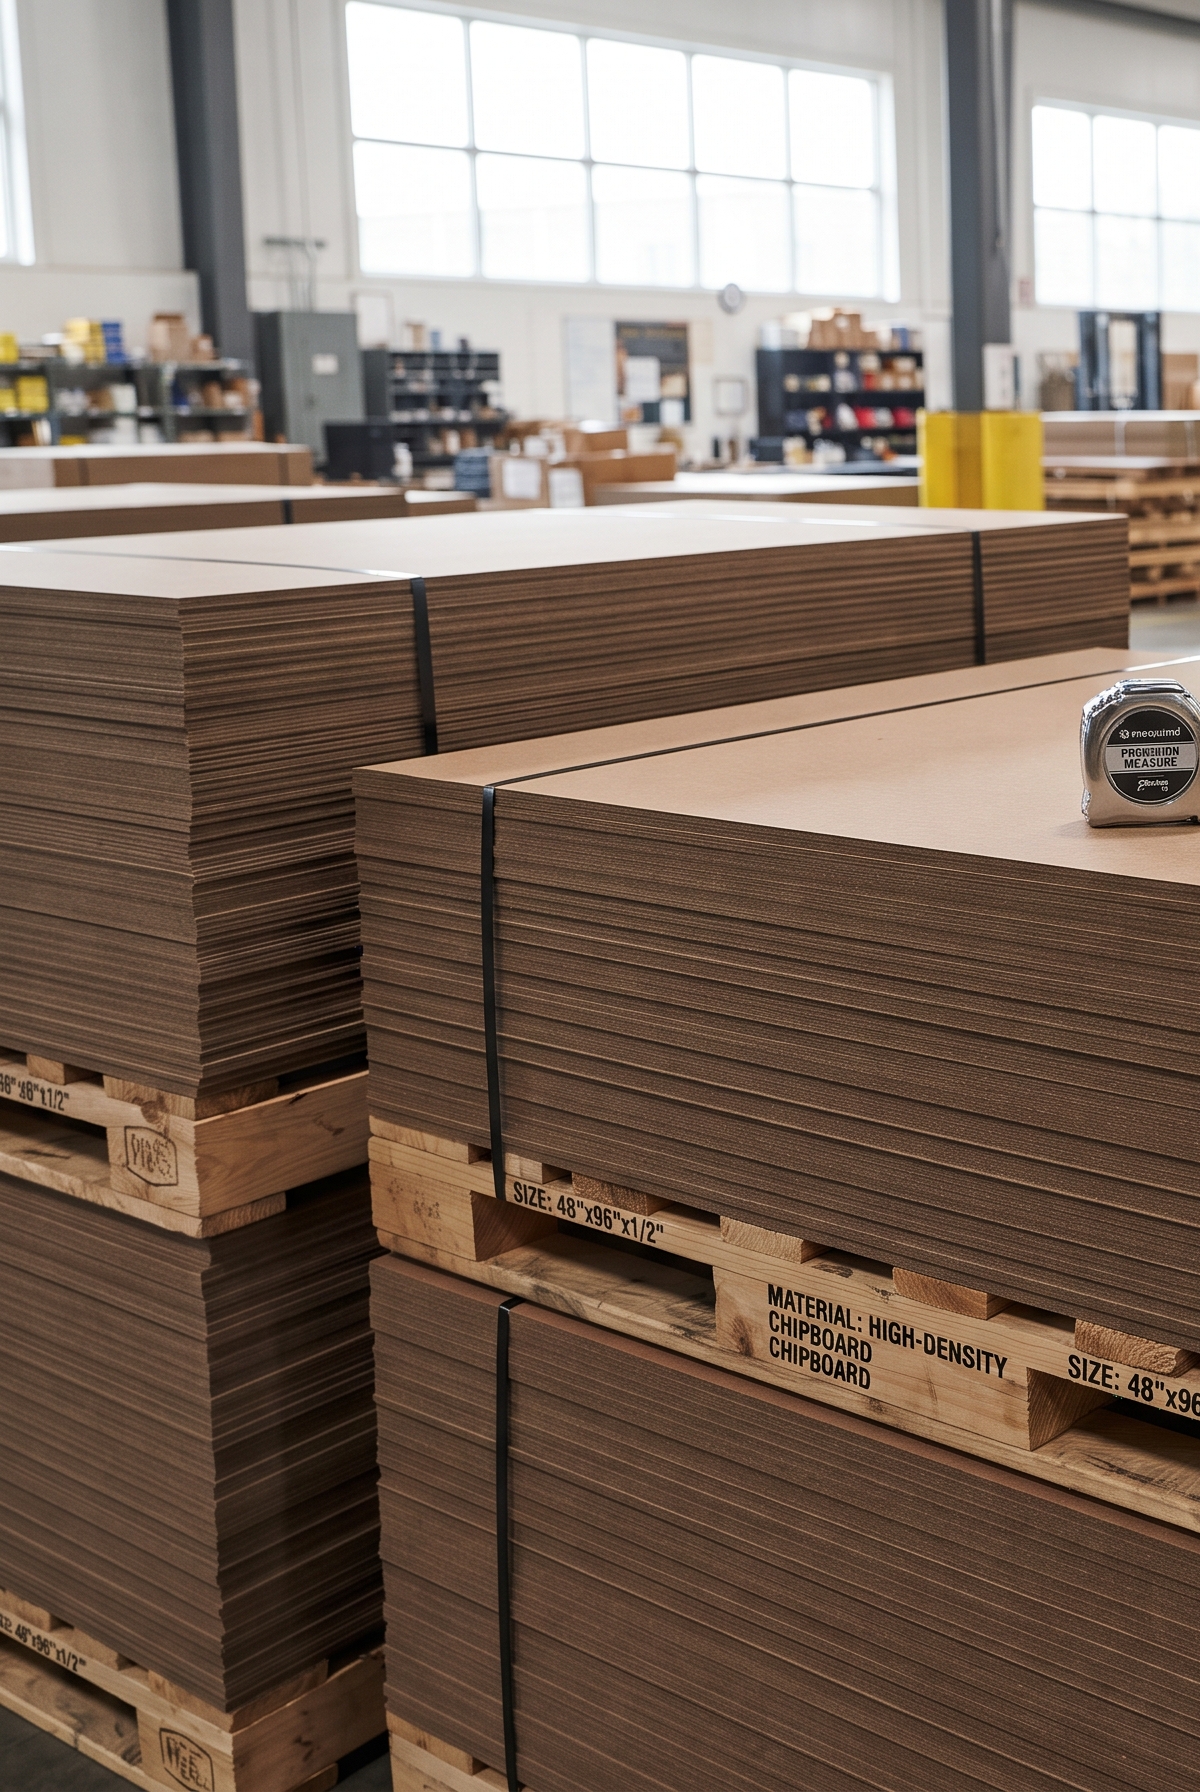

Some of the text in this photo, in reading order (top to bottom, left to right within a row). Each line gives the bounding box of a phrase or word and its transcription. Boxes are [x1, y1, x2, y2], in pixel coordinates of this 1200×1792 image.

[1124, 757, 1178, 769] MEASURE
[513, 1181, 664, 1244] SIZE: 48"x96"x1/2"
[767, 1283, 1008, 1379] MATERIAL: HIGH-DENSITY
[768, 1310, 873, 1364] CHIPBOARD
[768, 1336, 871, 1390] CHIPBOARD
[1067, 1354, 1120, 1391] SIZE:
